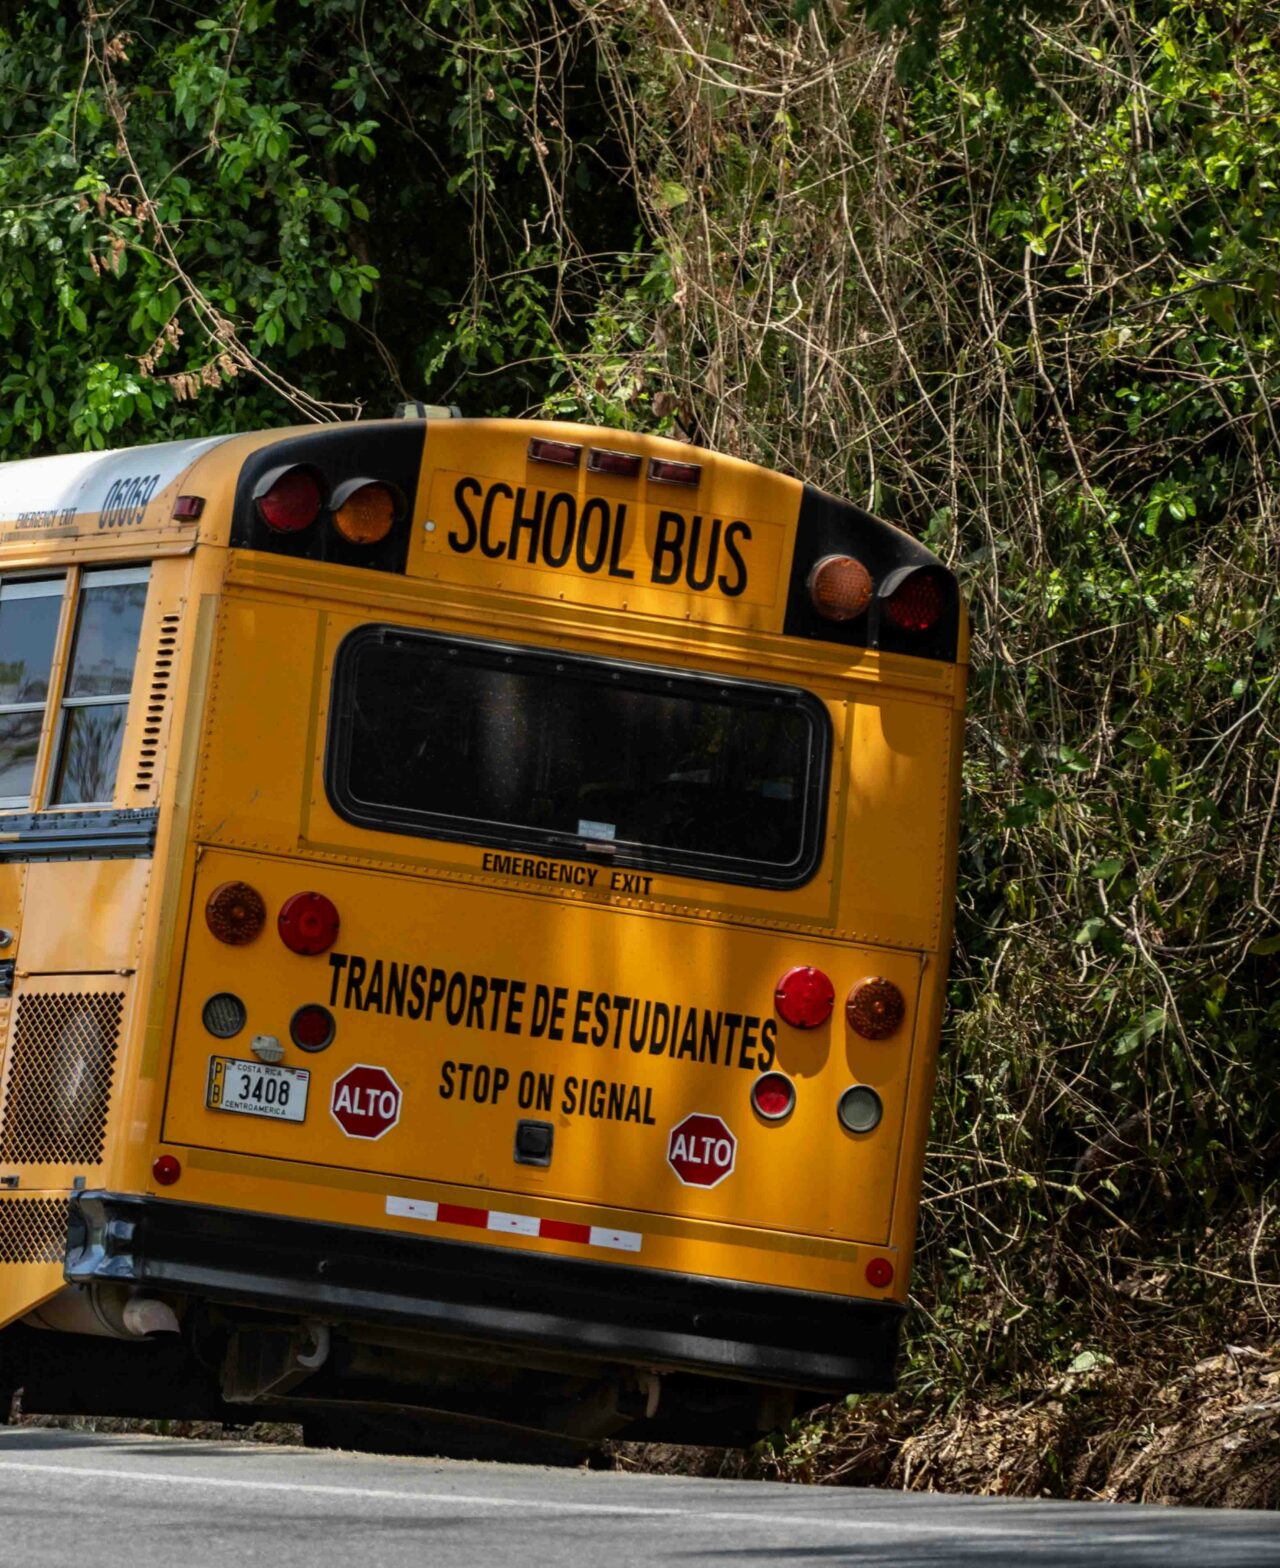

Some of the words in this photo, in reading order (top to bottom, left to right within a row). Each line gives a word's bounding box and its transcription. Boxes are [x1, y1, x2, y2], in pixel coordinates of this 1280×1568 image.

[99, 474, 160, 529] 06069
[448, 477, 635, 580] SCHOOL
[650, 510, 752, 597] BUS
[482, 853, 599, 887] EMERGENCY
[610, 872, 653, 896] EXIT
[328, 953, 526, 1036] TRANSPORTE
[530, 984, 569, 1042] DE
[571, 990, 777, 1072] ESTUDIANTES
[237, 1064, 261, 1074] COSTA
[265, 1066, 282, 1077] RICA
[239, 1074, 290, 1106] 3408
[225, 1100, 286, 1115] CENTROAMERICA
[334, 1085, 397, 1120] ALTO
[439, 1060, 509, 1104] STOP
[519, 1071, 554, 1112] ON
[562, 1077, 656, 1125] SIGNAL
[670, 1134, 733, 1167] ALTO
